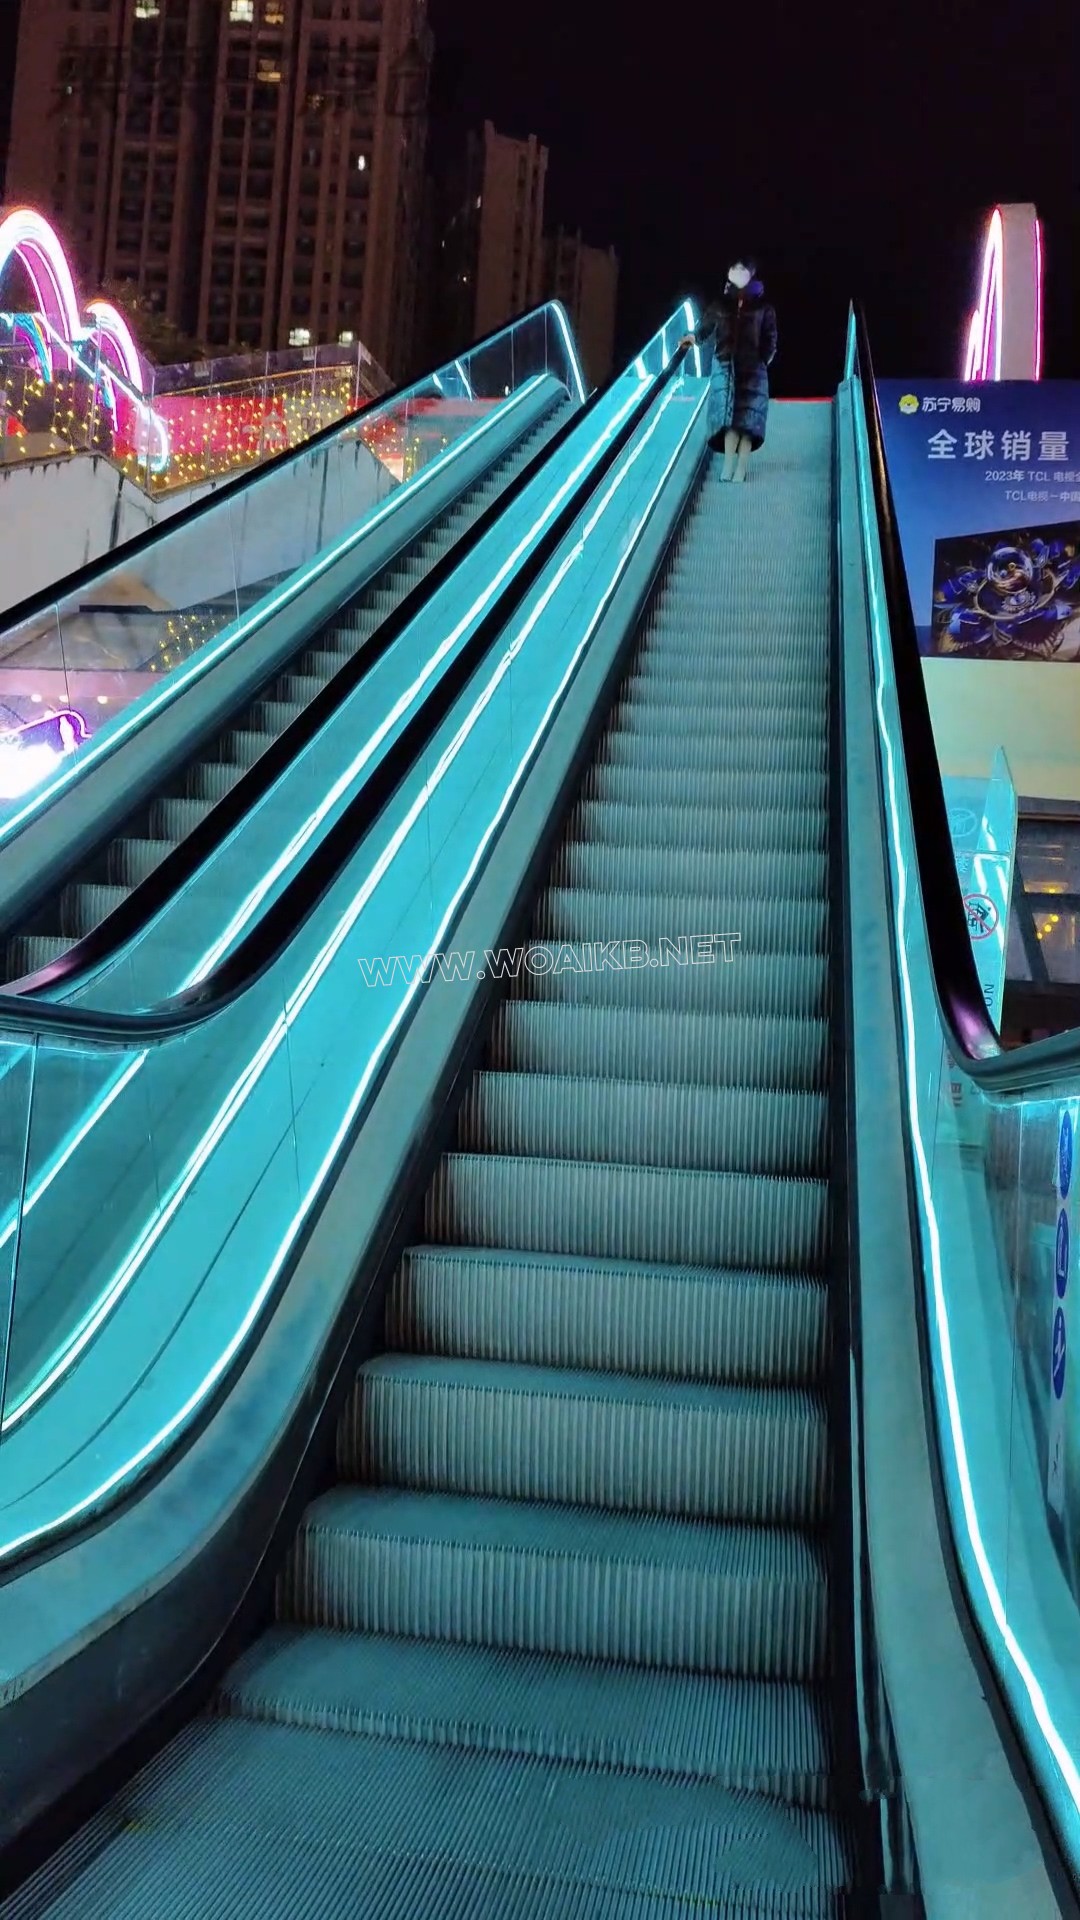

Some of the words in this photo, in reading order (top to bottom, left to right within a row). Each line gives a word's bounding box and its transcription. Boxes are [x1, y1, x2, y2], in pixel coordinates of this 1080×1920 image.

[922, 397, 981, 413] 苏宁易购
[927, 429, 1069, 461] 全球销量
[985, 470, 1025, 481] 2023年
[1028, 471, 1050, 481] TCL
